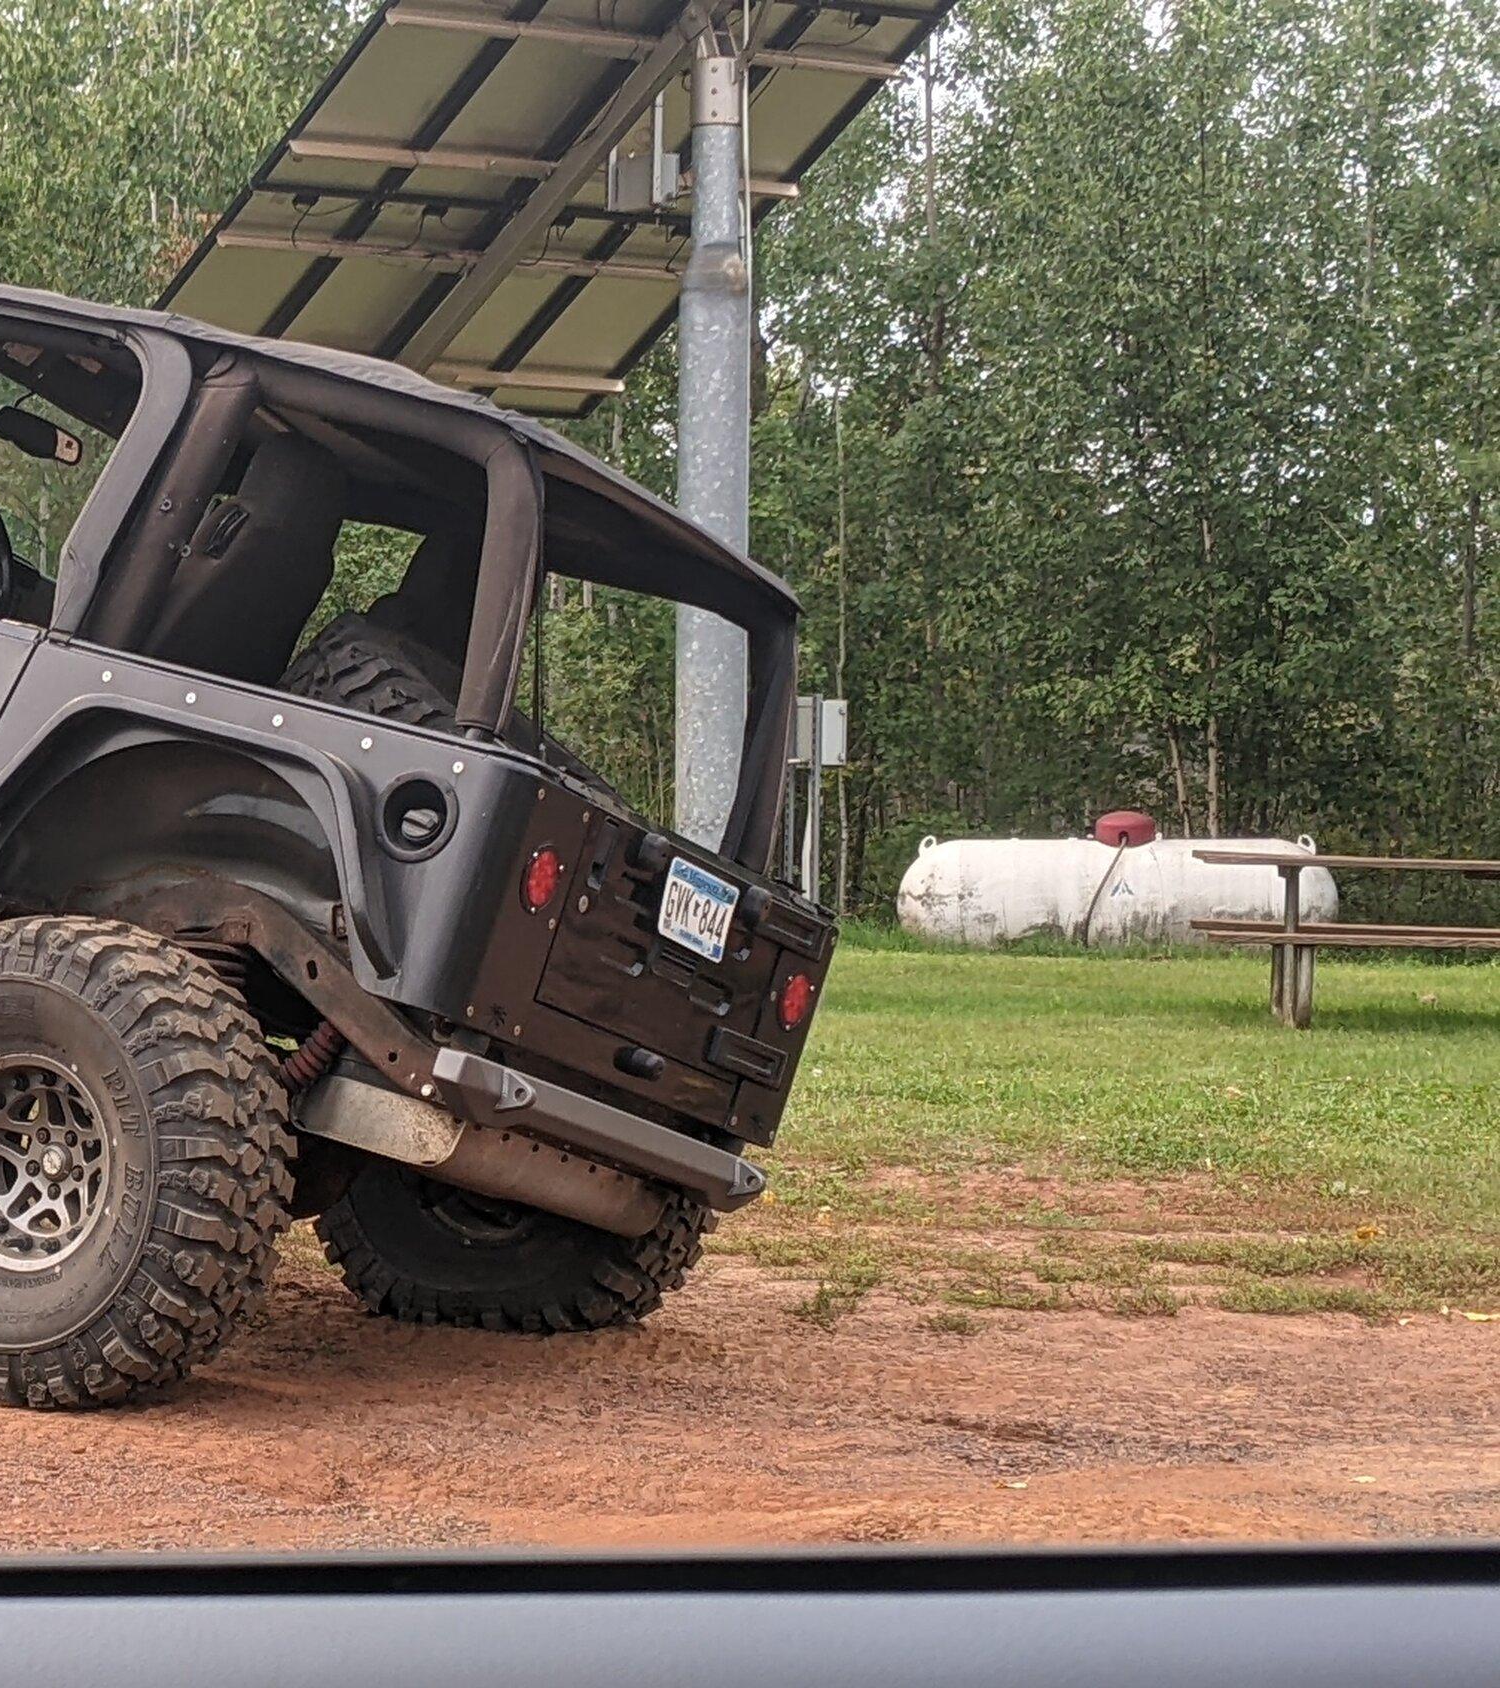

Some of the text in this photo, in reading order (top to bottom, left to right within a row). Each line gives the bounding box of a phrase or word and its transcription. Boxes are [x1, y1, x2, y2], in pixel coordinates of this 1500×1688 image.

[665, 881, 696, 927] GVK
[698, 899, 728, 944] 844
[98, 1067, 146, 1276] PIT BULL
